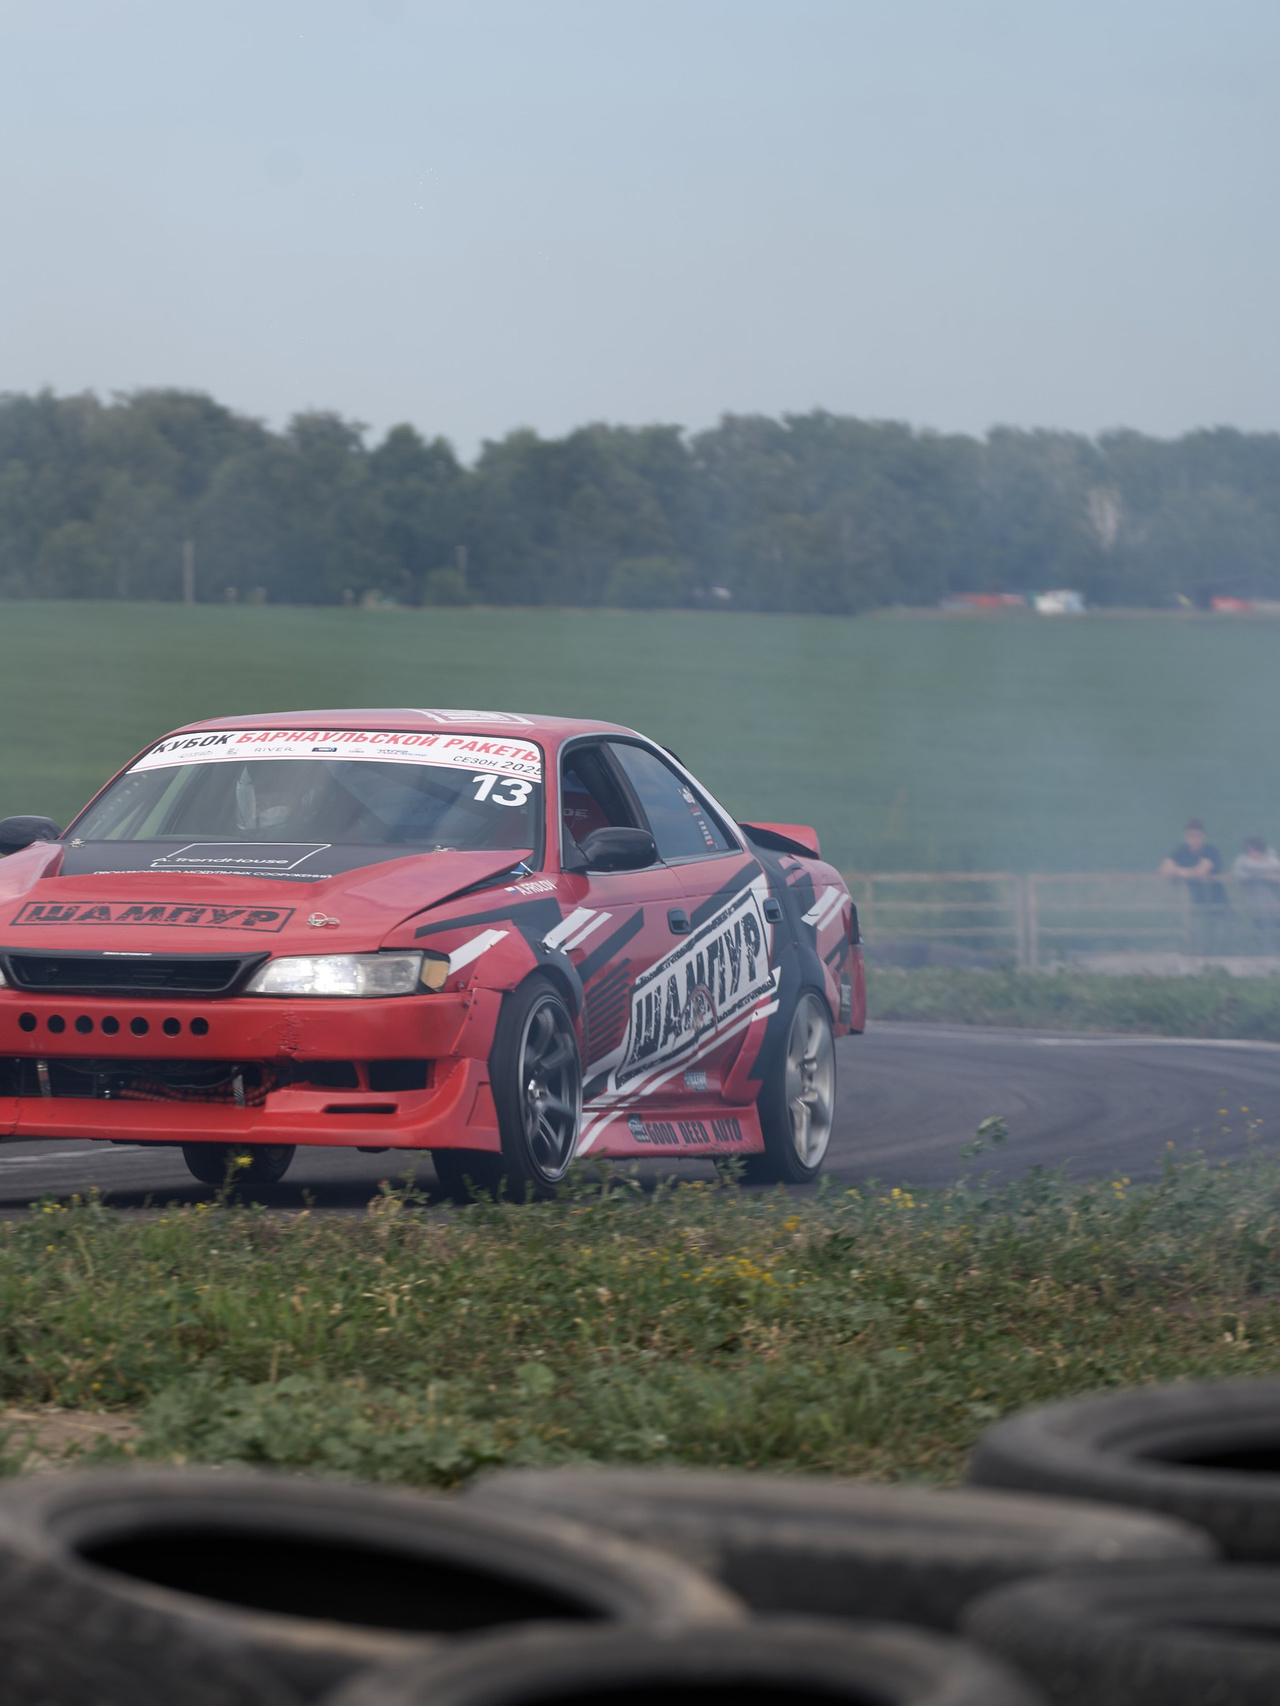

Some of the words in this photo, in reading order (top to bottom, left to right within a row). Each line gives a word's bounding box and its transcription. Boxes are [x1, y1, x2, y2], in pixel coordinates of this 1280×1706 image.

[153, 733, 235, 755] КУБОК
[236, 731, 440, 748] БАРНАУЛЬСКОЙ
[453, 755, 498, 768] СЕЗОН
[500, 761, 542, 776] 2025
[472, 773, 533, 807] 13
[24, 904, 281, 927] ШАМПУР
[625, 911, 761, 1067] ШАМПУР
[645, 1121, 680, 1145] GOOD
[677, 1120, 711, 1144] DEED
[710, 1117, 744, 1142] AUTO
